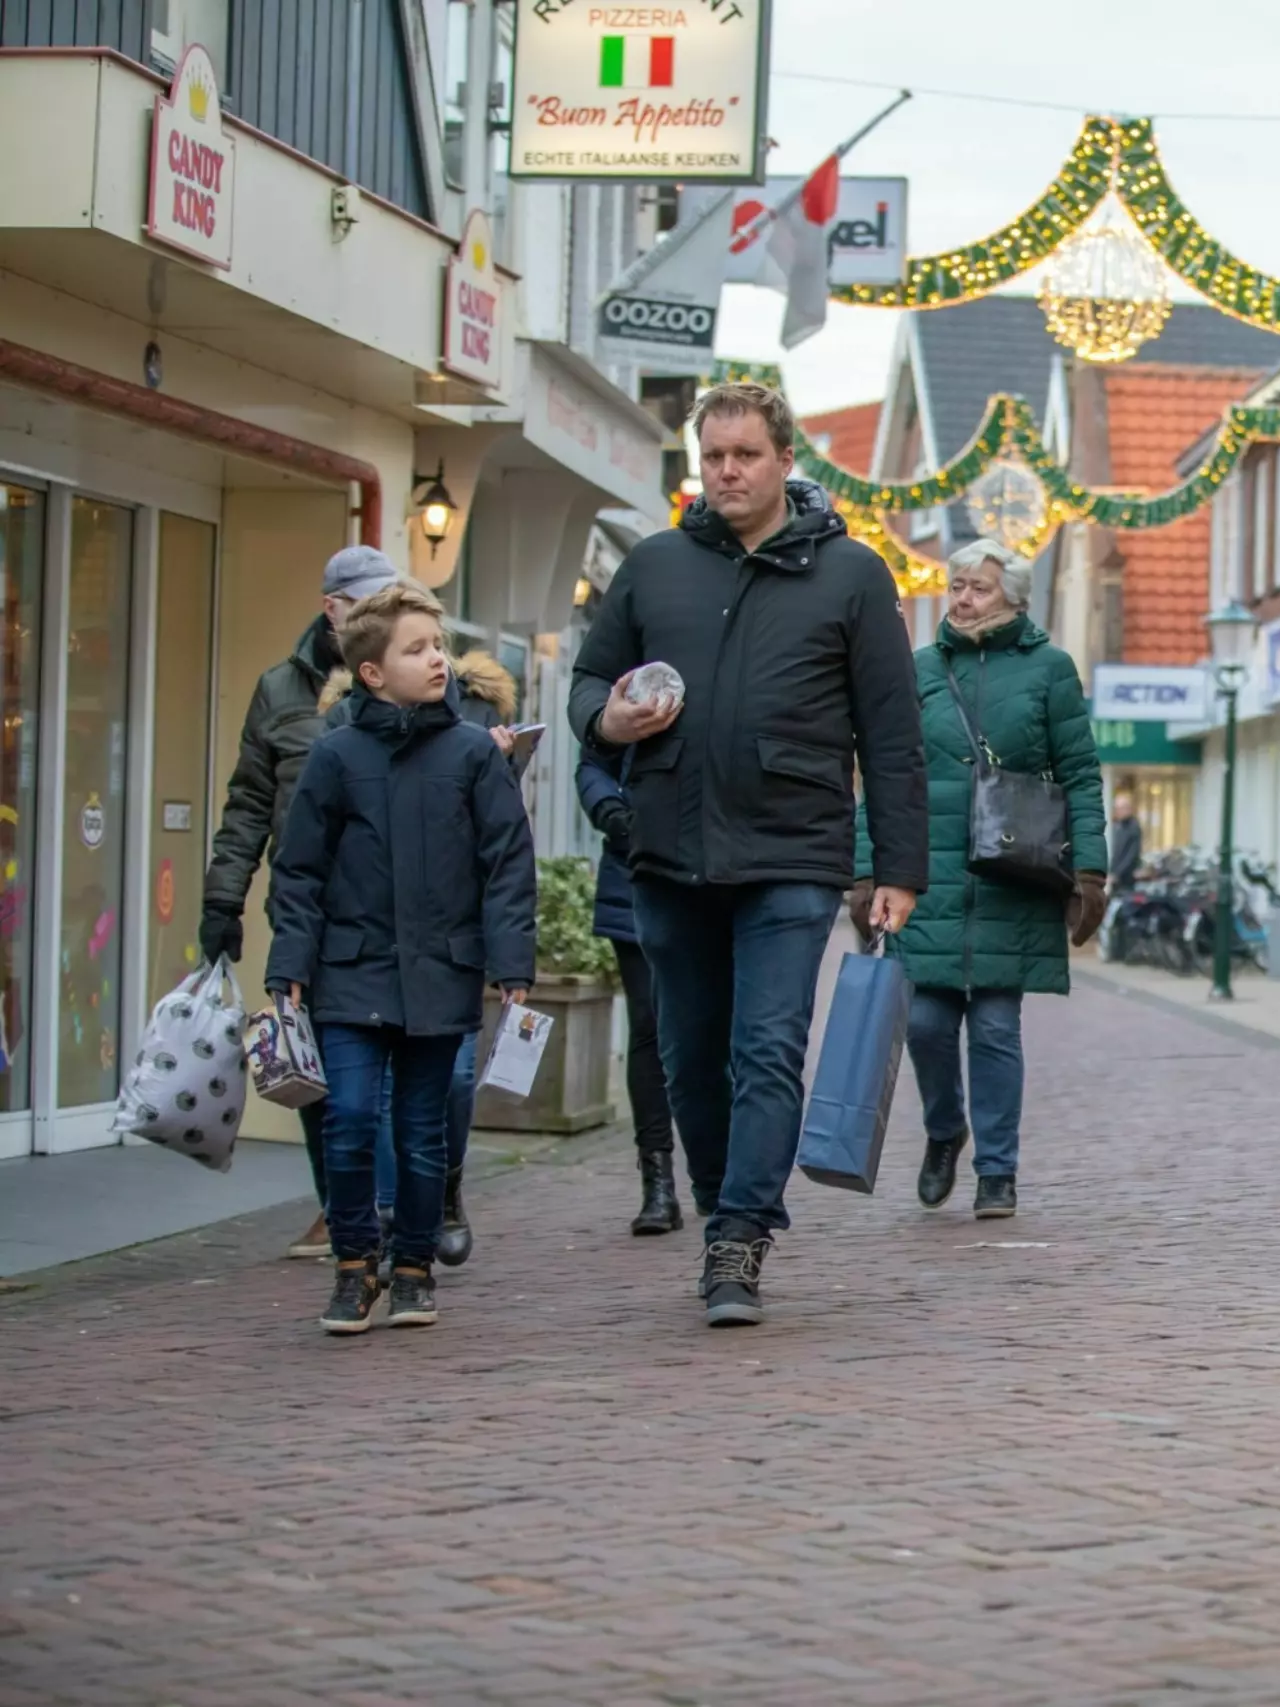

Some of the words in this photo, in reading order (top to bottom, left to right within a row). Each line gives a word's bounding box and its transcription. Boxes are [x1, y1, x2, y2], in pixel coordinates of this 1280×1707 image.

[588, 9, 687, 28] PIZZERIA
[168, 128, 224, 194] CANDY
[523, 152, 574, 166] ECHTE
[580, 152, 669, 166] ITALIAANSE
[675, 152, 741, 167] KEUKEN
[172, 180, 215, 239] KING
[458, 280, 496, 328] CANDY
[605, 299, 712, 333] OOZOO
[461, 320, 490, 365] KING
[1112, 683, 1188, 704] ACTION
